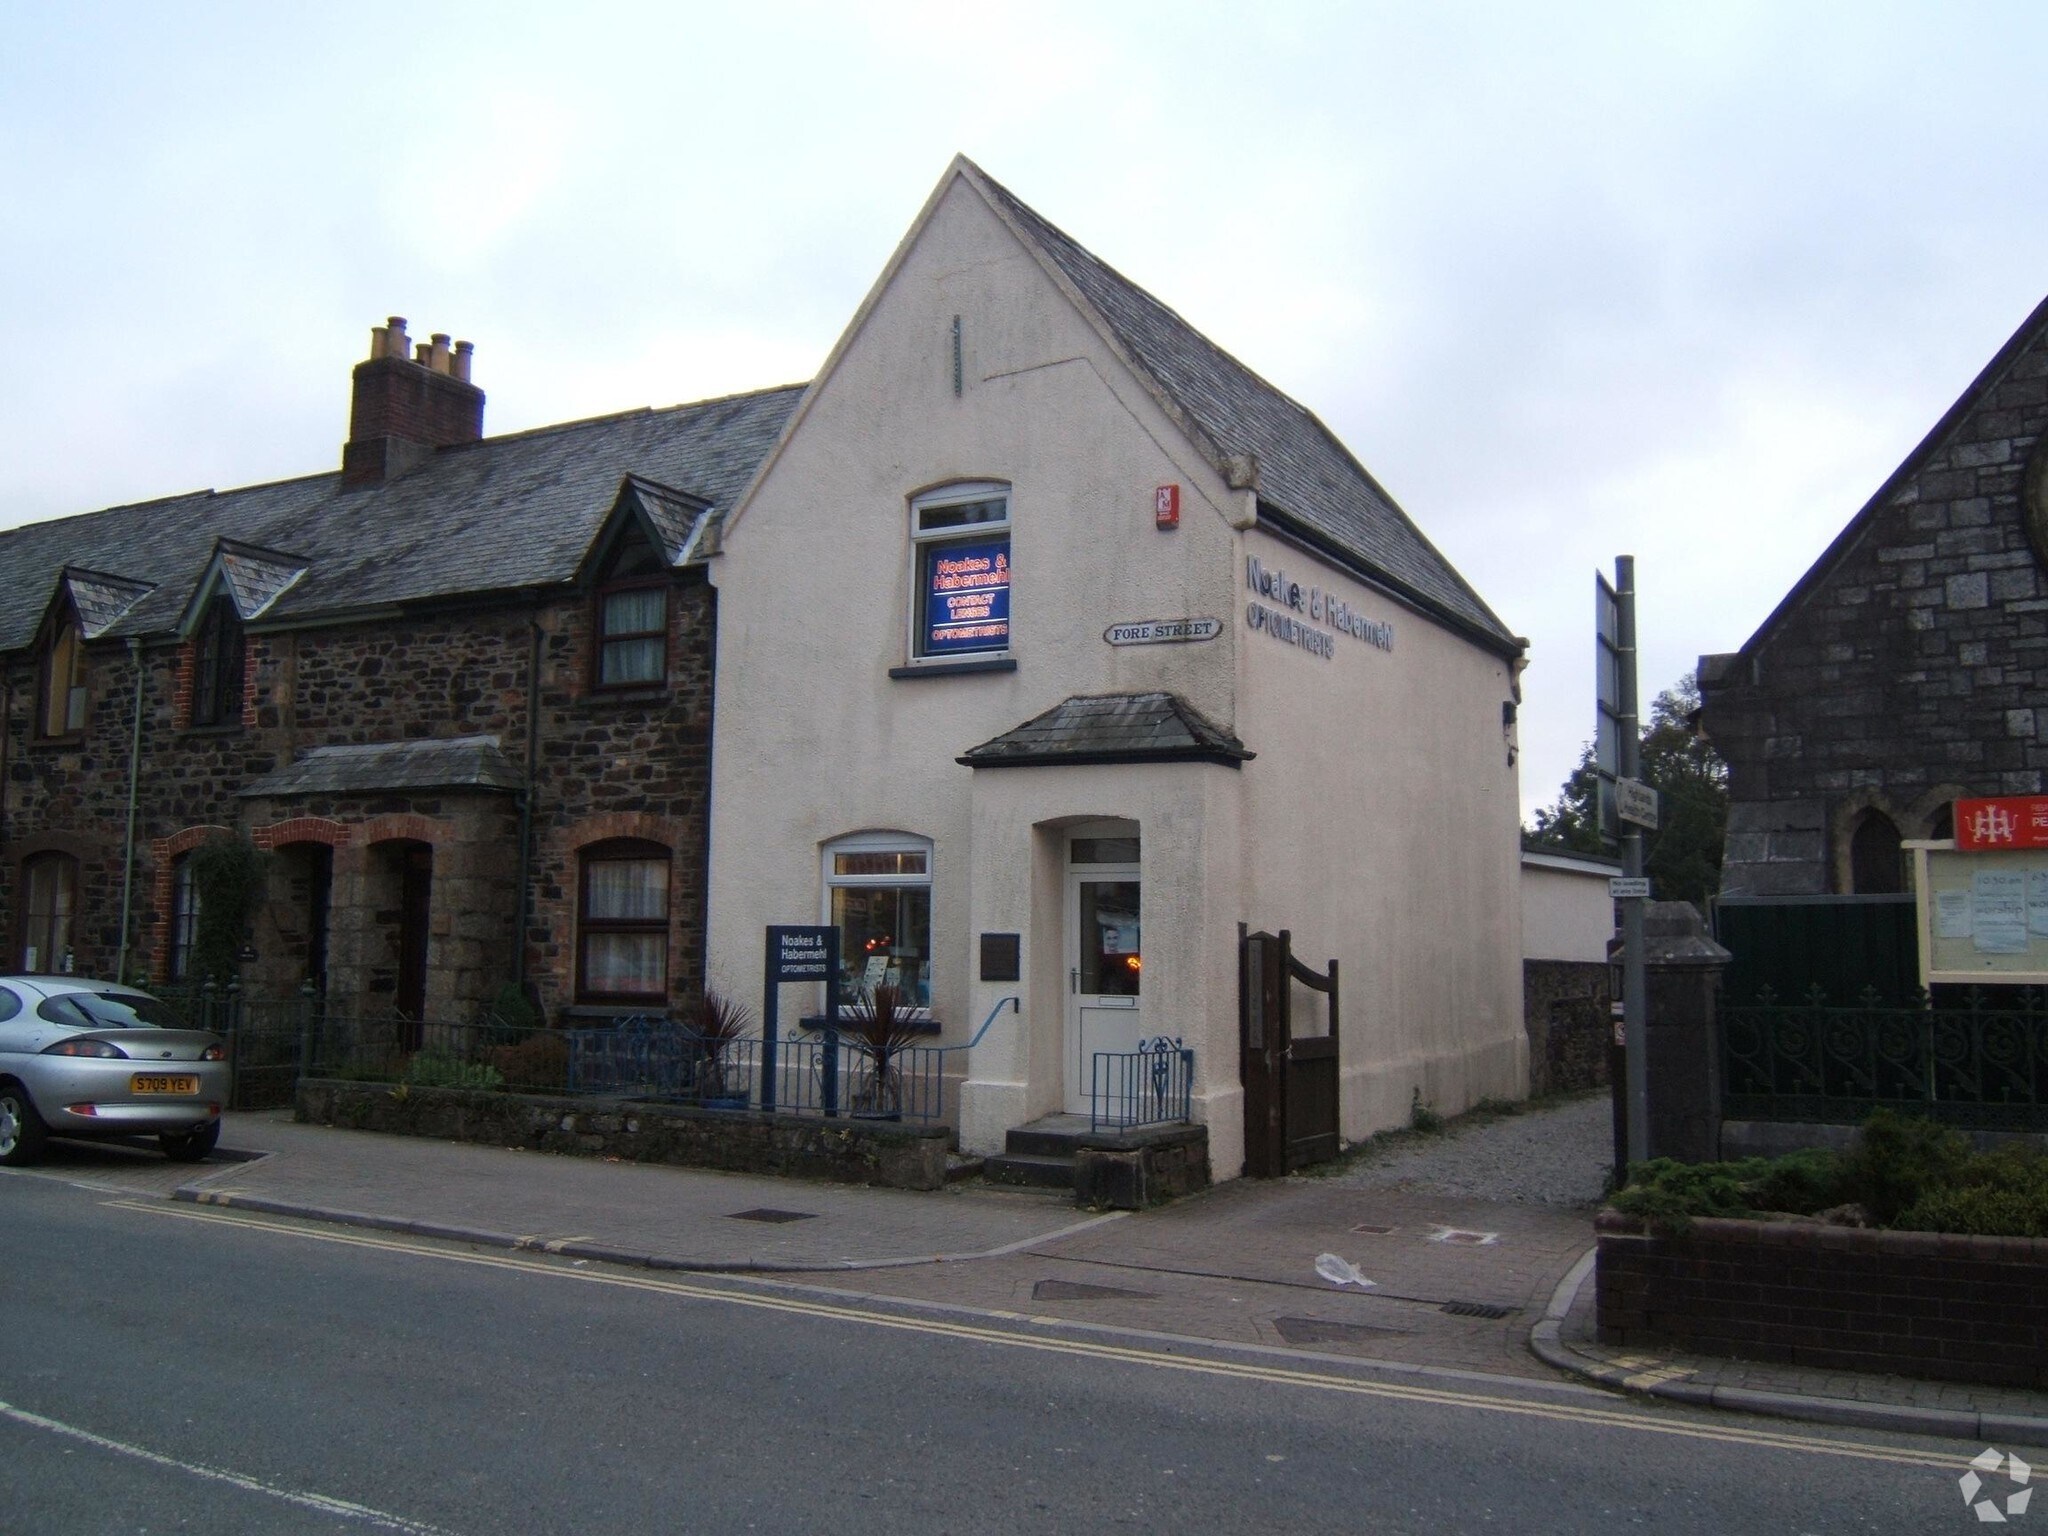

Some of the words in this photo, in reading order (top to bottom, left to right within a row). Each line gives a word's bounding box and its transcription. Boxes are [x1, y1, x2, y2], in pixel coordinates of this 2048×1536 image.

[937, 557, 990, 574] Noakes
[995, 553, 1007, 569] &
[946, 593, 996, 608] CONTACT
[1246, 554, 1307, 613] Noakes
[1311, 585, 1322, 620] &
[1325, 593, 1394, 652] Habermehl
[950, 606, 990, 619] LENSES
[932, 624, 1008, 640] OPTOMETRISTS
[1113, 627, 1150, 640] FORE
[1155, 623, 1212, 637] STREET
[1246, 600, 1334, 659] OPTOMETRISTS
[781, 934, 814, 946] Noakes
[816, 934, 823, 946] &
[781, 948, 827, 960] Habermehl
[136, 1077, 168, 1091] S709
[170, 1077, 193, 1092] YEV
